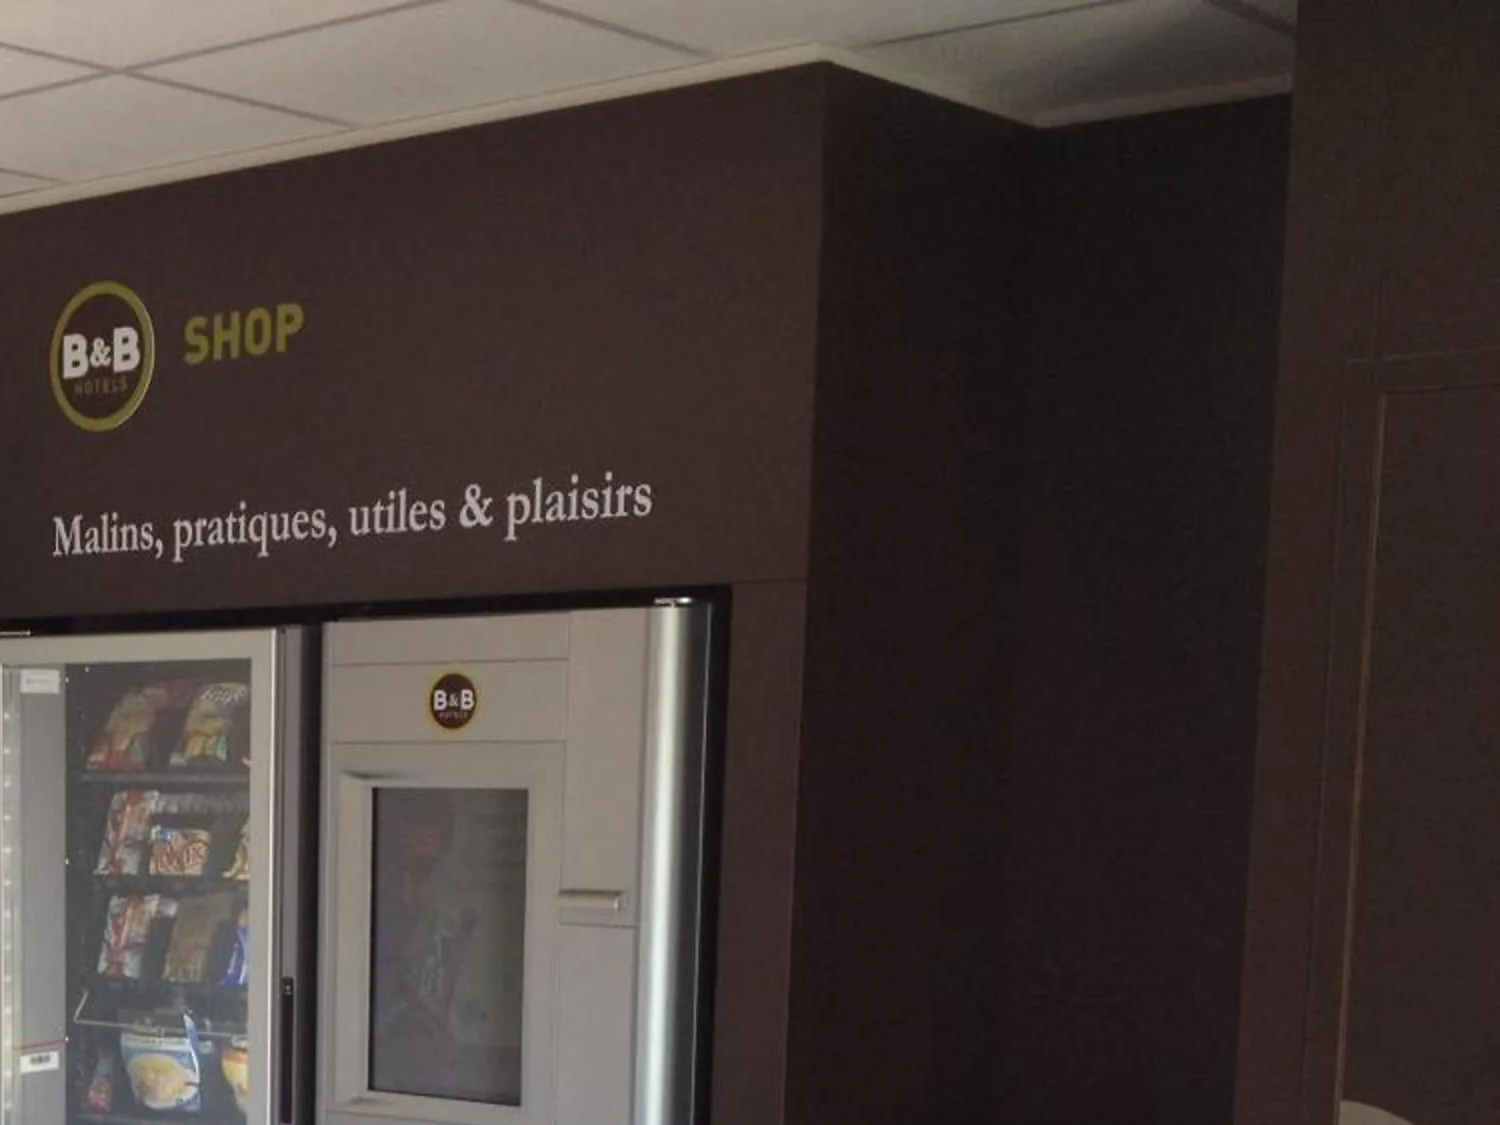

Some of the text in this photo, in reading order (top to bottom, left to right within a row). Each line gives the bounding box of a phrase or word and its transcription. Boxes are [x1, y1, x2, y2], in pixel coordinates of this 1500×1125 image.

[62, 326, 141, 379] B&B
[183, 303, 304, 365] SHOP
[52, 471, 653, 562] Malins, pratiques, utiles & plaisirs
[433, 688, 476, 711] B&B
